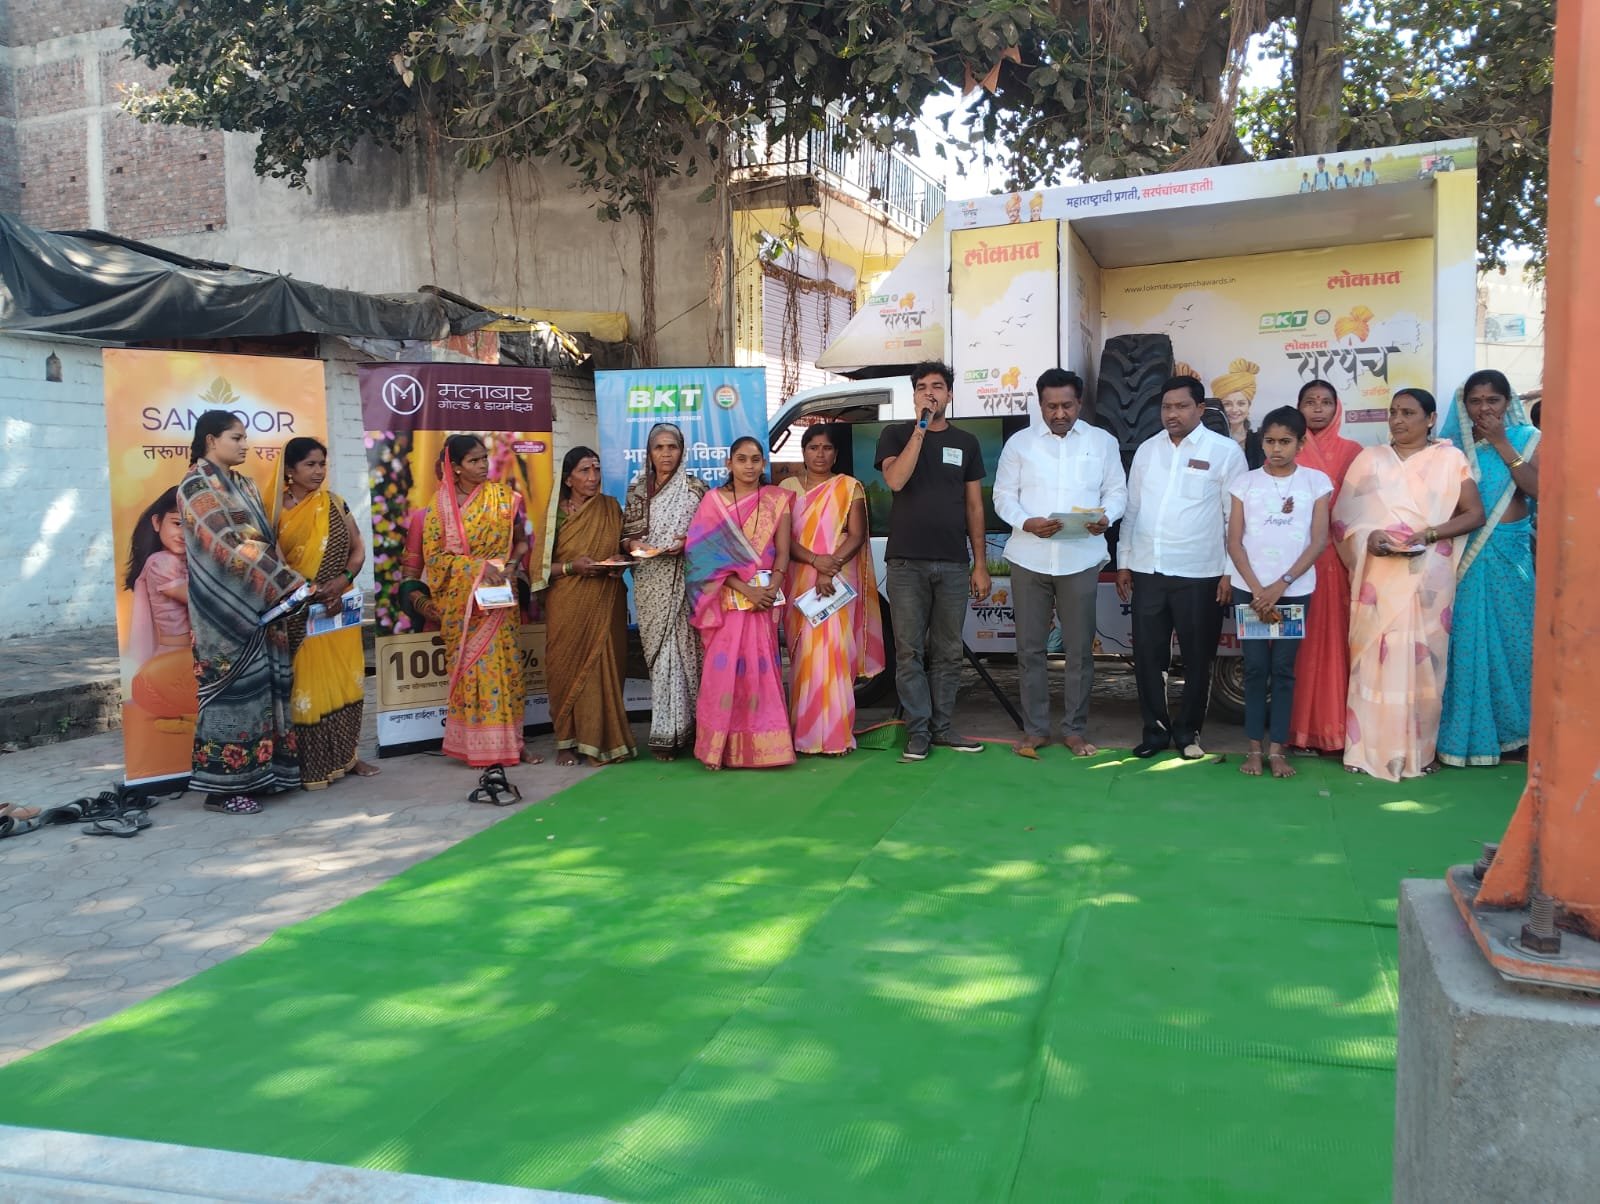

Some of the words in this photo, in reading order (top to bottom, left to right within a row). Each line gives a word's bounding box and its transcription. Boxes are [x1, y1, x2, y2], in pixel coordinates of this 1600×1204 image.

[1066, 189, 1112, 208] महाराष्ट्राची
[1114, 186, 1140, 201] प्रगती,
[1142, 182, 1188, 198] सरपंचांच्या
[964, 241, 1042, 267] लोकमत
[1124, 277, 1236, 294] www.lokmatsarpanchawards.in
[1327, 269, 1402, 290] लोकमत
[1260, 312, 1307, 329] BKT
[1284, 339, 1328, 352] लोकमत
[437, 383, 533, 400] मलाबार
[628, 388, 702, 408] BKT
[438, 398, 471, 410] गोल्ड
[473, 401, 481, 410] &
[142, 407, 294, 433] SANOOR
[1263, 515, 1294, 526] Angel
